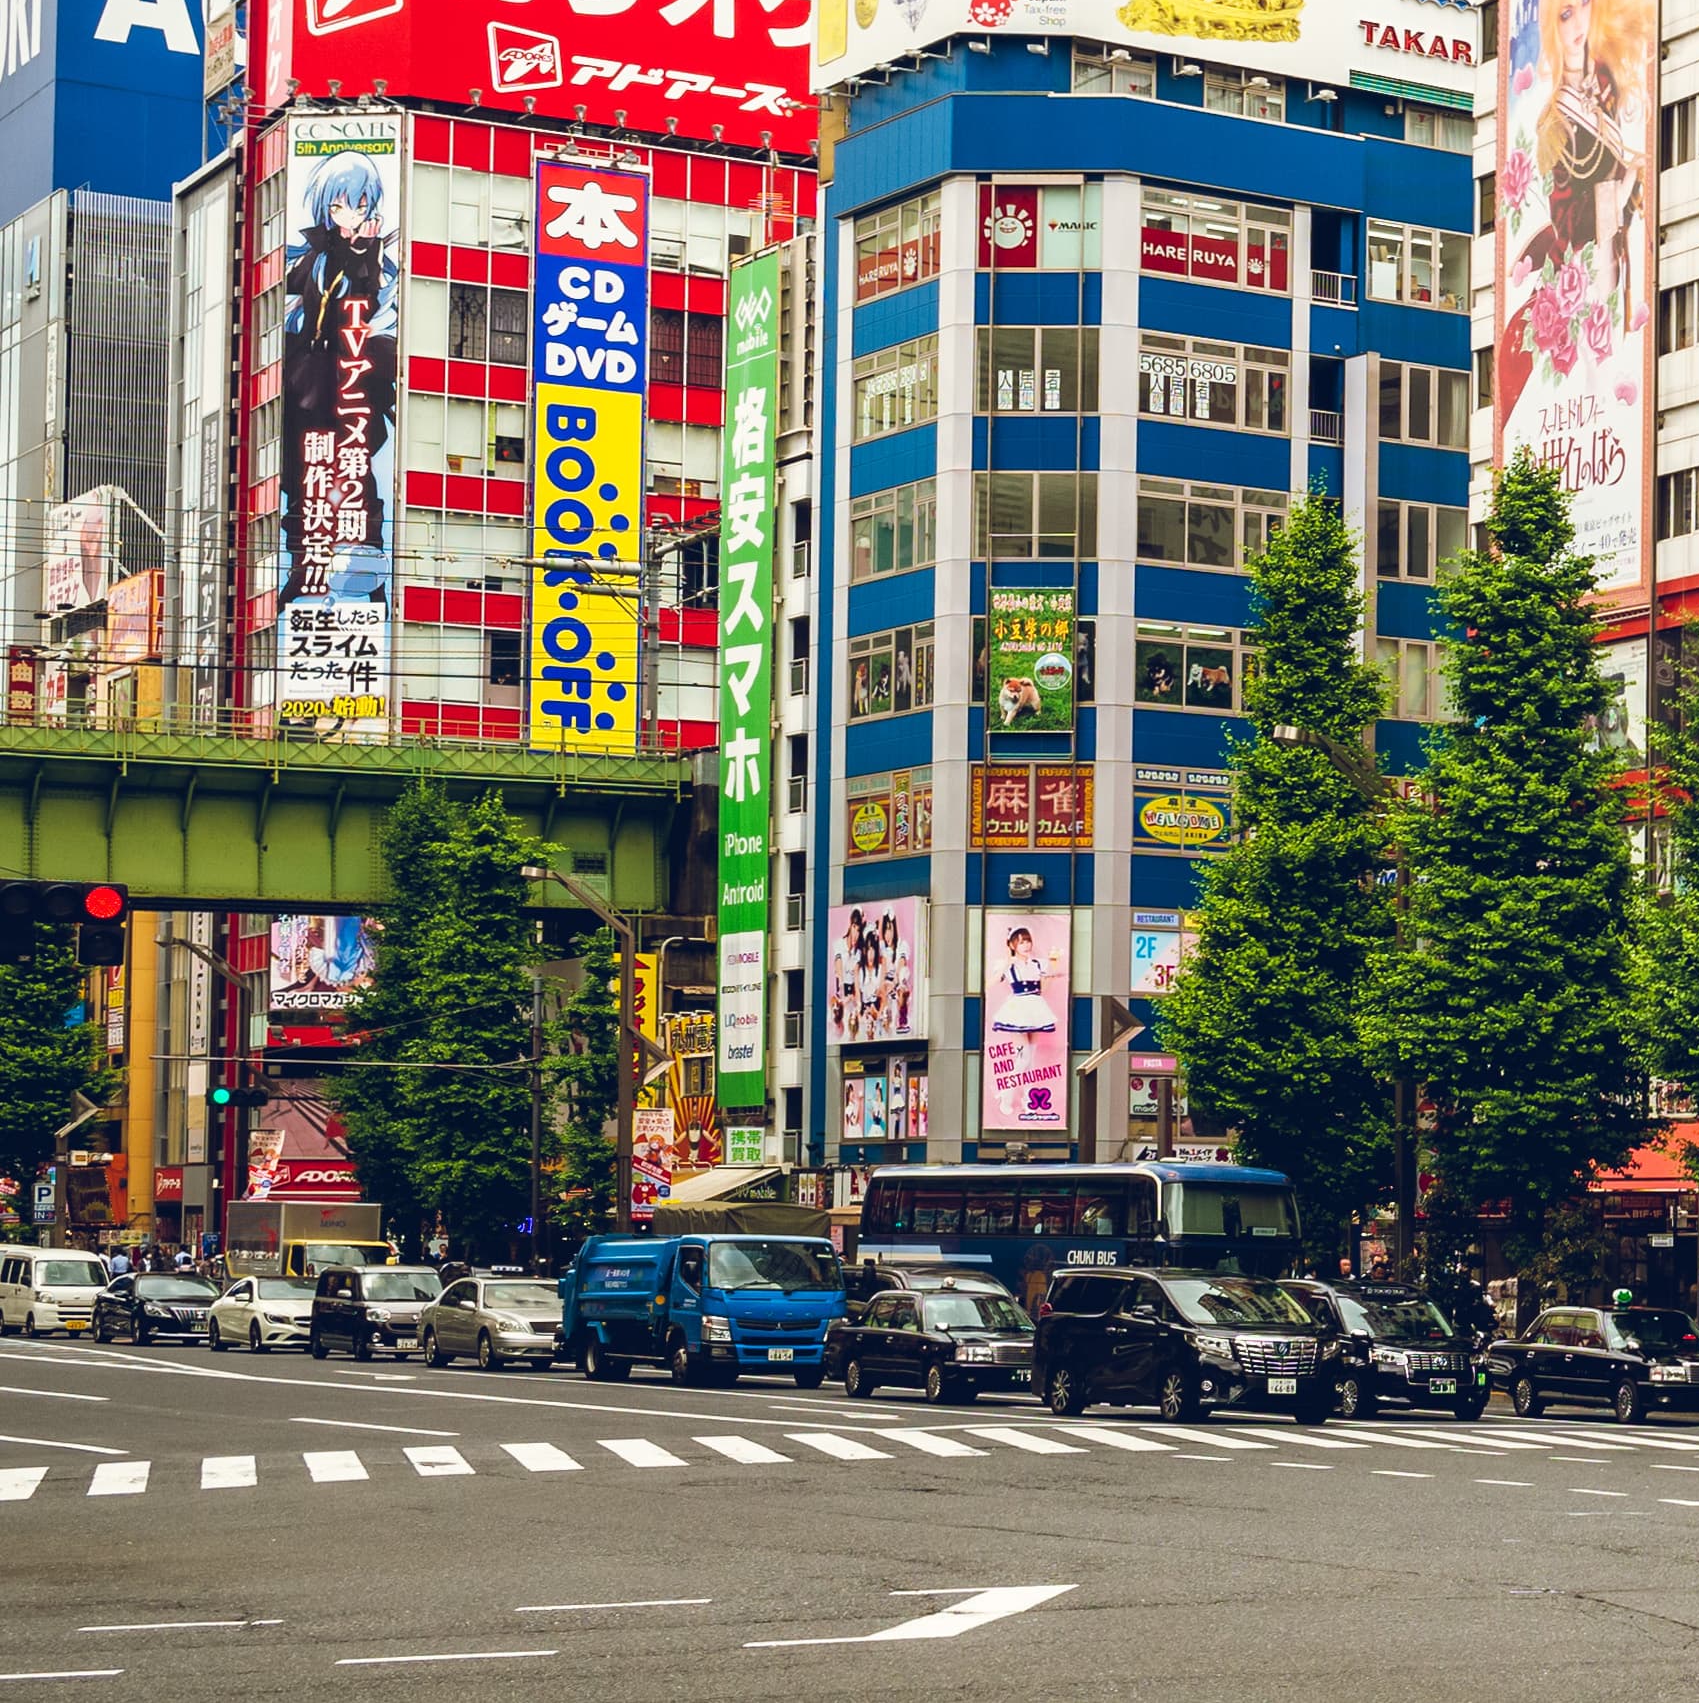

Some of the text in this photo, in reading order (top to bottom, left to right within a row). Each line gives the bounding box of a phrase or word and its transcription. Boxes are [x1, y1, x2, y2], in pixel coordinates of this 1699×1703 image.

[1039, 15, 1067, 29] Shop
[571, 55, 792, 116] アドアーズ
[296, 142, 317, 155] 5th
[546, 182, 638, 249] 本
[558, 266, 626, 304] CD
[543, 302, 639, 346] ゲーム
[545, 342, 637, 385] DVD
[1140, 354, 1236, 383] 5685 6805
[336, 299, 373, 542] TVアニメ第2期
[725, 386, 767, 803] 格安スマホ
[290, 610, 379, 631] 転生したら
[290, 635, 378, 657] スライム
[290, 660, 378, 693] だった件
[987, 780, 1081, 815] 麻雀
[725, 833, 762, 857] iPhone
[722, 878, 764, 906] Android
[1136, 936, 1157, 959] 2F
[989, 1042, 1015, 1059] CAFE
[994, 1059, 1014, 1075] AND
[997, 1065, 1062, 1090] RESTAURANT
[38, 1187, 52, 1202] P
[1067, 1250, 1117, 1266] CHUKI BUS
